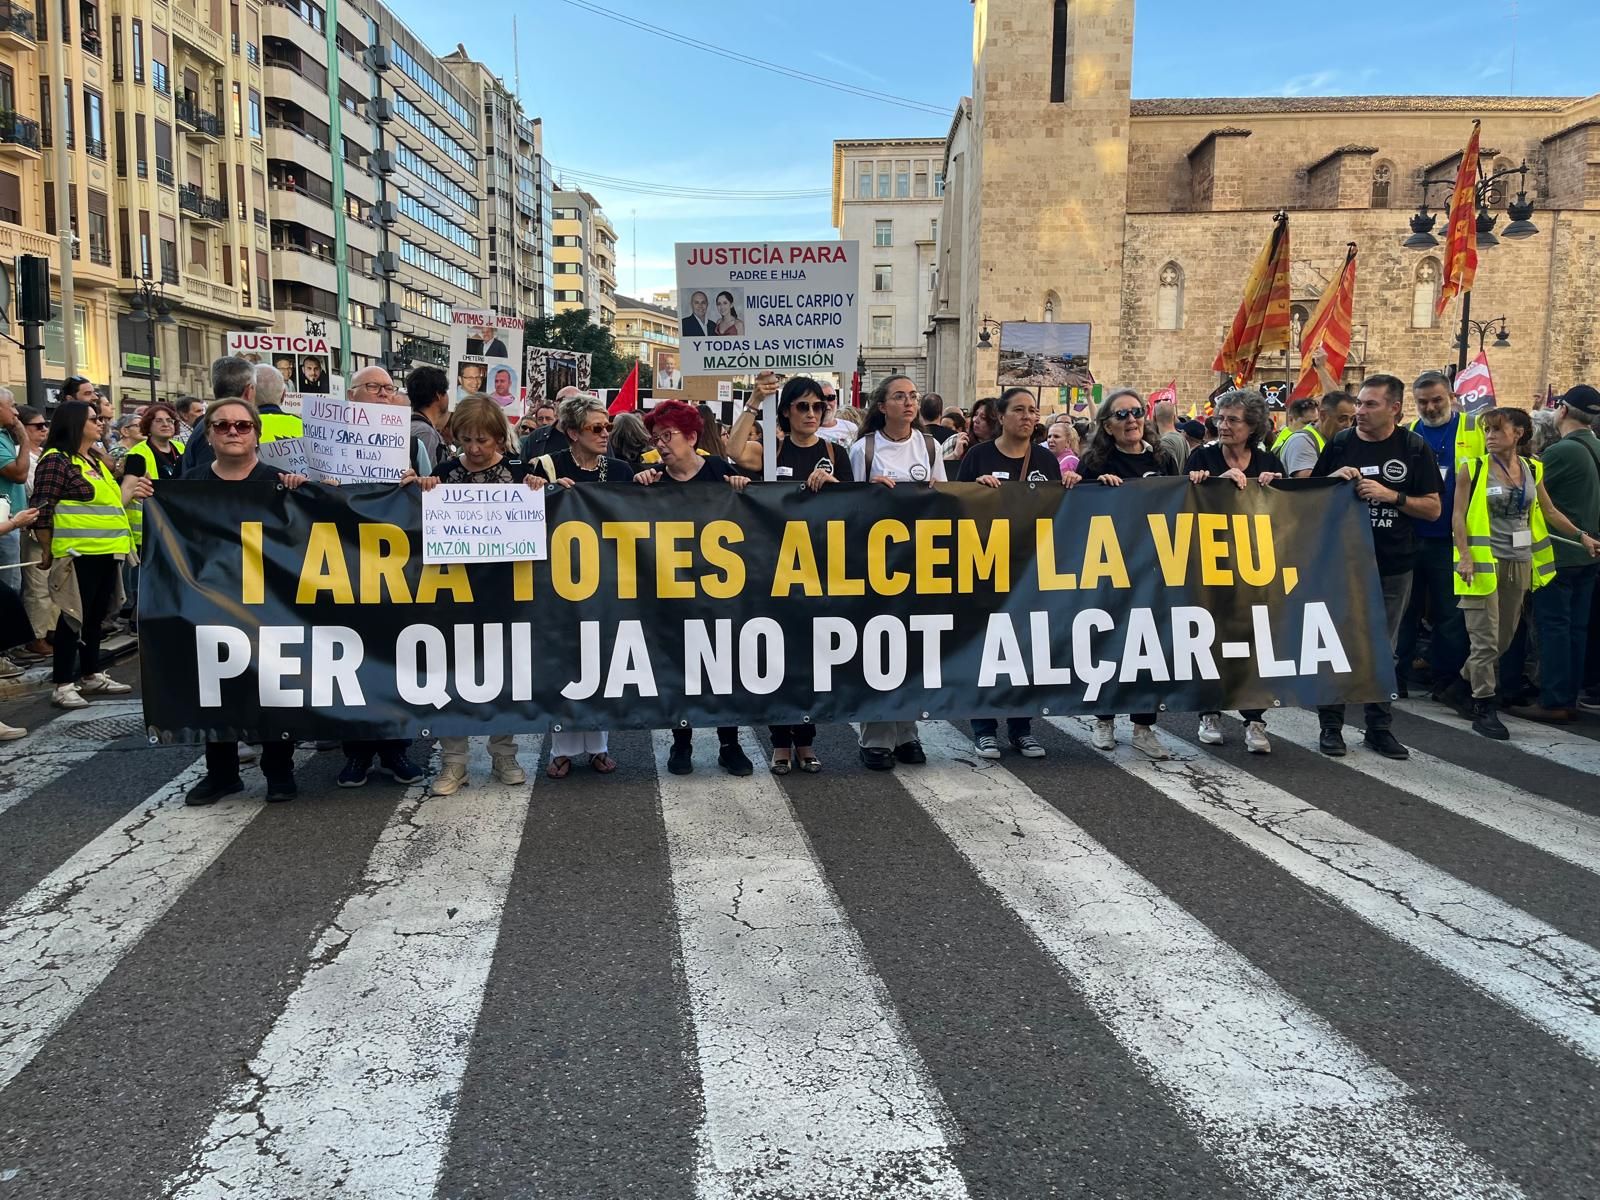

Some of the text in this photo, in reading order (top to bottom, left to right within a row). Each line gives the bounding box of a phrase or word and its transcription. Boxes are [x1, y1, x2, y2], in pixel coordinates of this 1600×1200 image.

[790, 246, 847, 264] PARA
[729, 269, 806, 280] PADRE E HIJA
[746, 293, 855, 309] MIGUEL CARPIO Y
[451, 311, 484, 326] VICTIMAS
[758, 313, 842, 327] SARA CARPIO
[231, 335, 328, 353] JUSTICIA
[693, 338, 844, 351] Y TODAS LAS VICTIMAS
[703, 351, 834, 369] MAZÓN DIMISIÓN
[380, 413, 403, 425] PARA
[303, 423, 405, 448] MIGUEL Y SARA CARPIO
[269, 439, 304, 458] JUSTI
[341, 448, 348, 456] E
[336, 464, 354, 474] LAS
[442, 489, 523, 502] JUSTICIA
[425, 508, 545, 521] PARA TODAS LAS VÍCTIMAS
[426, 526, 437, 535] DE
[426, 539, 536, 557] MAZÓN DIMISIÓN
[242, 523, 264, 603] I
[772, 518, 1010, 596] ALCEM
[1036, 517, 1128, 589] LA
[1149, 513, 1297, 591] VEU,
[195, 602, 1352, 710] PER QUI JA NO POT ALÇAR-LA
